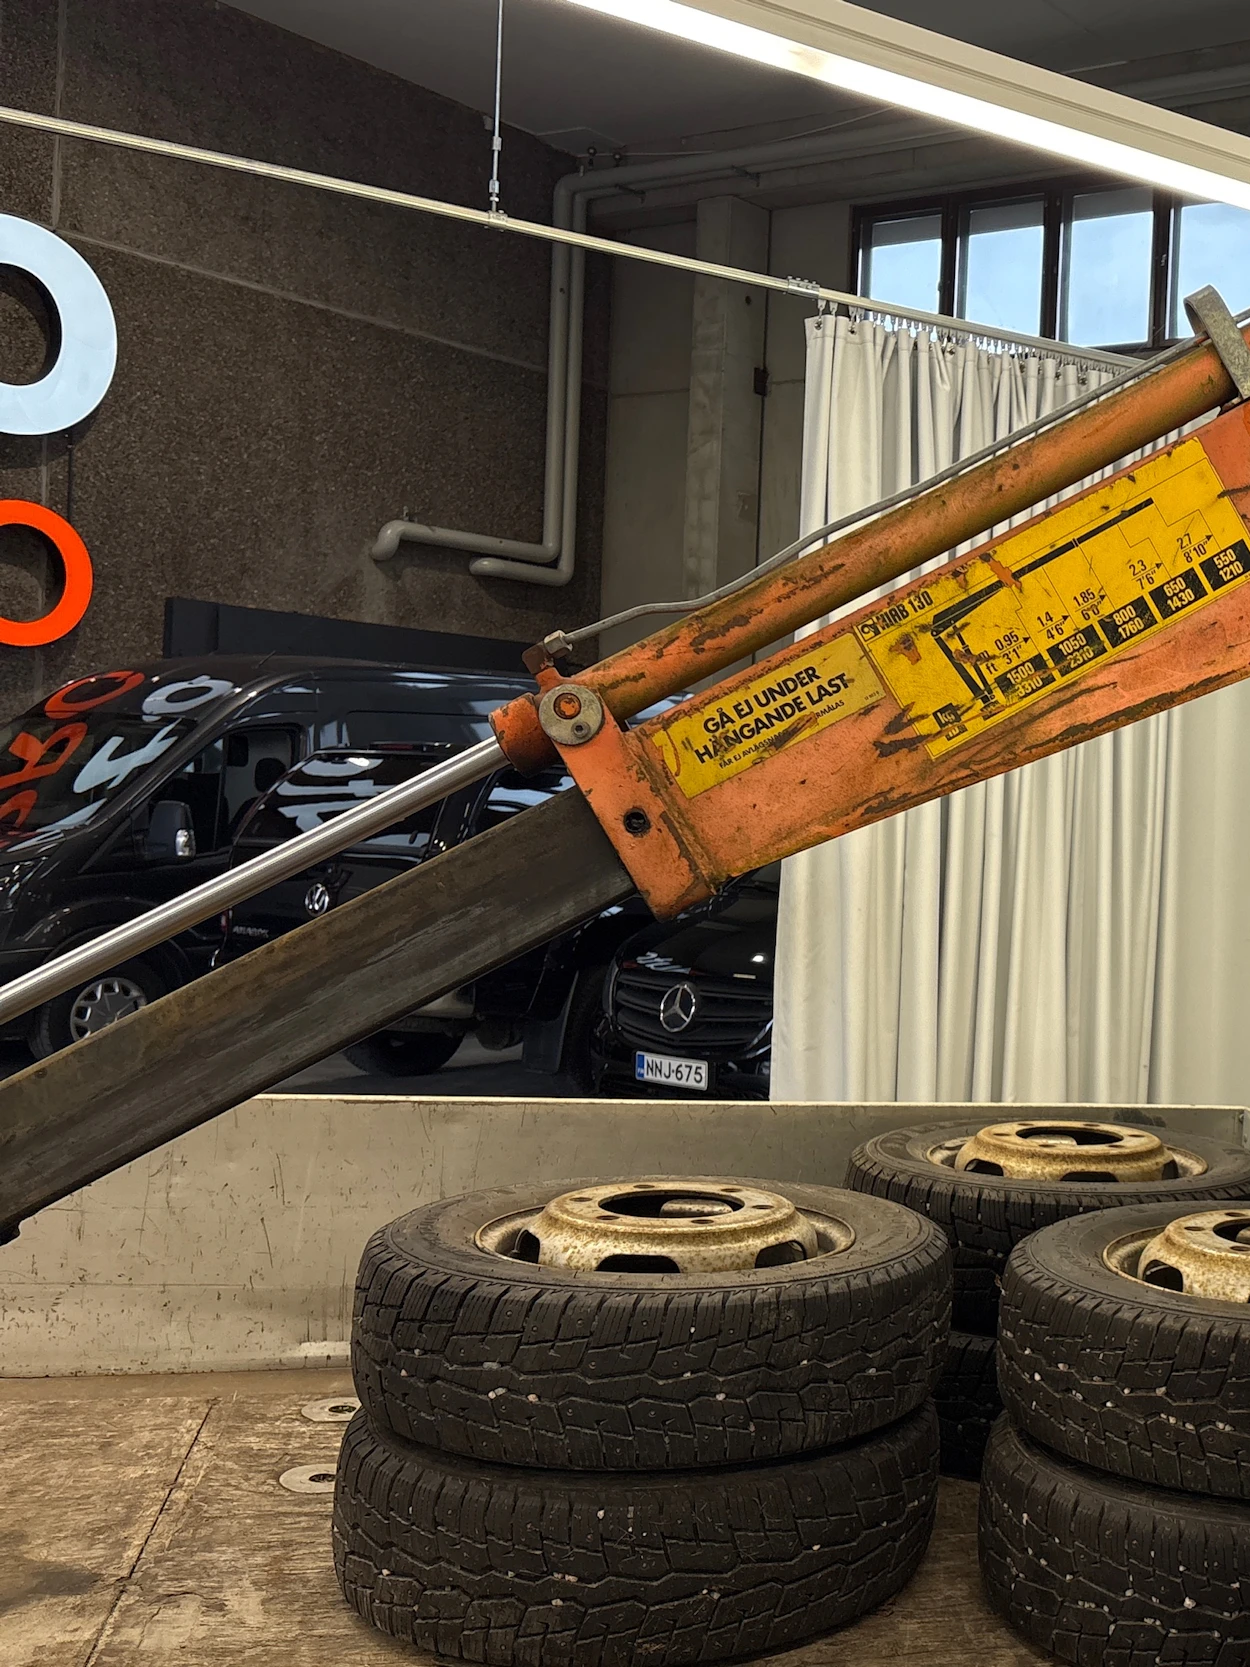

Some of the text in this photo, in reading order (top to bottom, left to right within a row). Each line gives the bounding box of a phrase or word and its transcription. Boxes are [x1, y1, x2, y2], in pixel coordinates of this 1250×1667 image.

[1177, 533, 1192, 550] 2.7
[1128, 559, 1147, 577] 2.3
[1213, 548, 1237, 569] 550
[1219, 561, 1244, 582] 1210
[1163, 576, 1187, 597] 650
[908, 590, 934, 613] 130
[1073, 588, 1096, 608] 1.85
[1167, 588, 1196, 611] 1430
[1036, 611, 1054, 628] 1.4
[1112, 605, 1137, 626] 800
[1118, 617, 1145, 640] 1760
[994, 631, 1020, 651] 0.95
[1058, 633, 1087, 656] 1050
[1066, 645, 1094, 669] 2310
[985, 661, 999, 675] ft
[1006, 661, 1035, 685] 1500
[807, 673, 850, 706] LAST
[1015, 676, 1043, 698] 3310
[703, 666, 822, 734] GÅ EJ UNDER
[646, 1058, 703, 1084] NNJ-675
